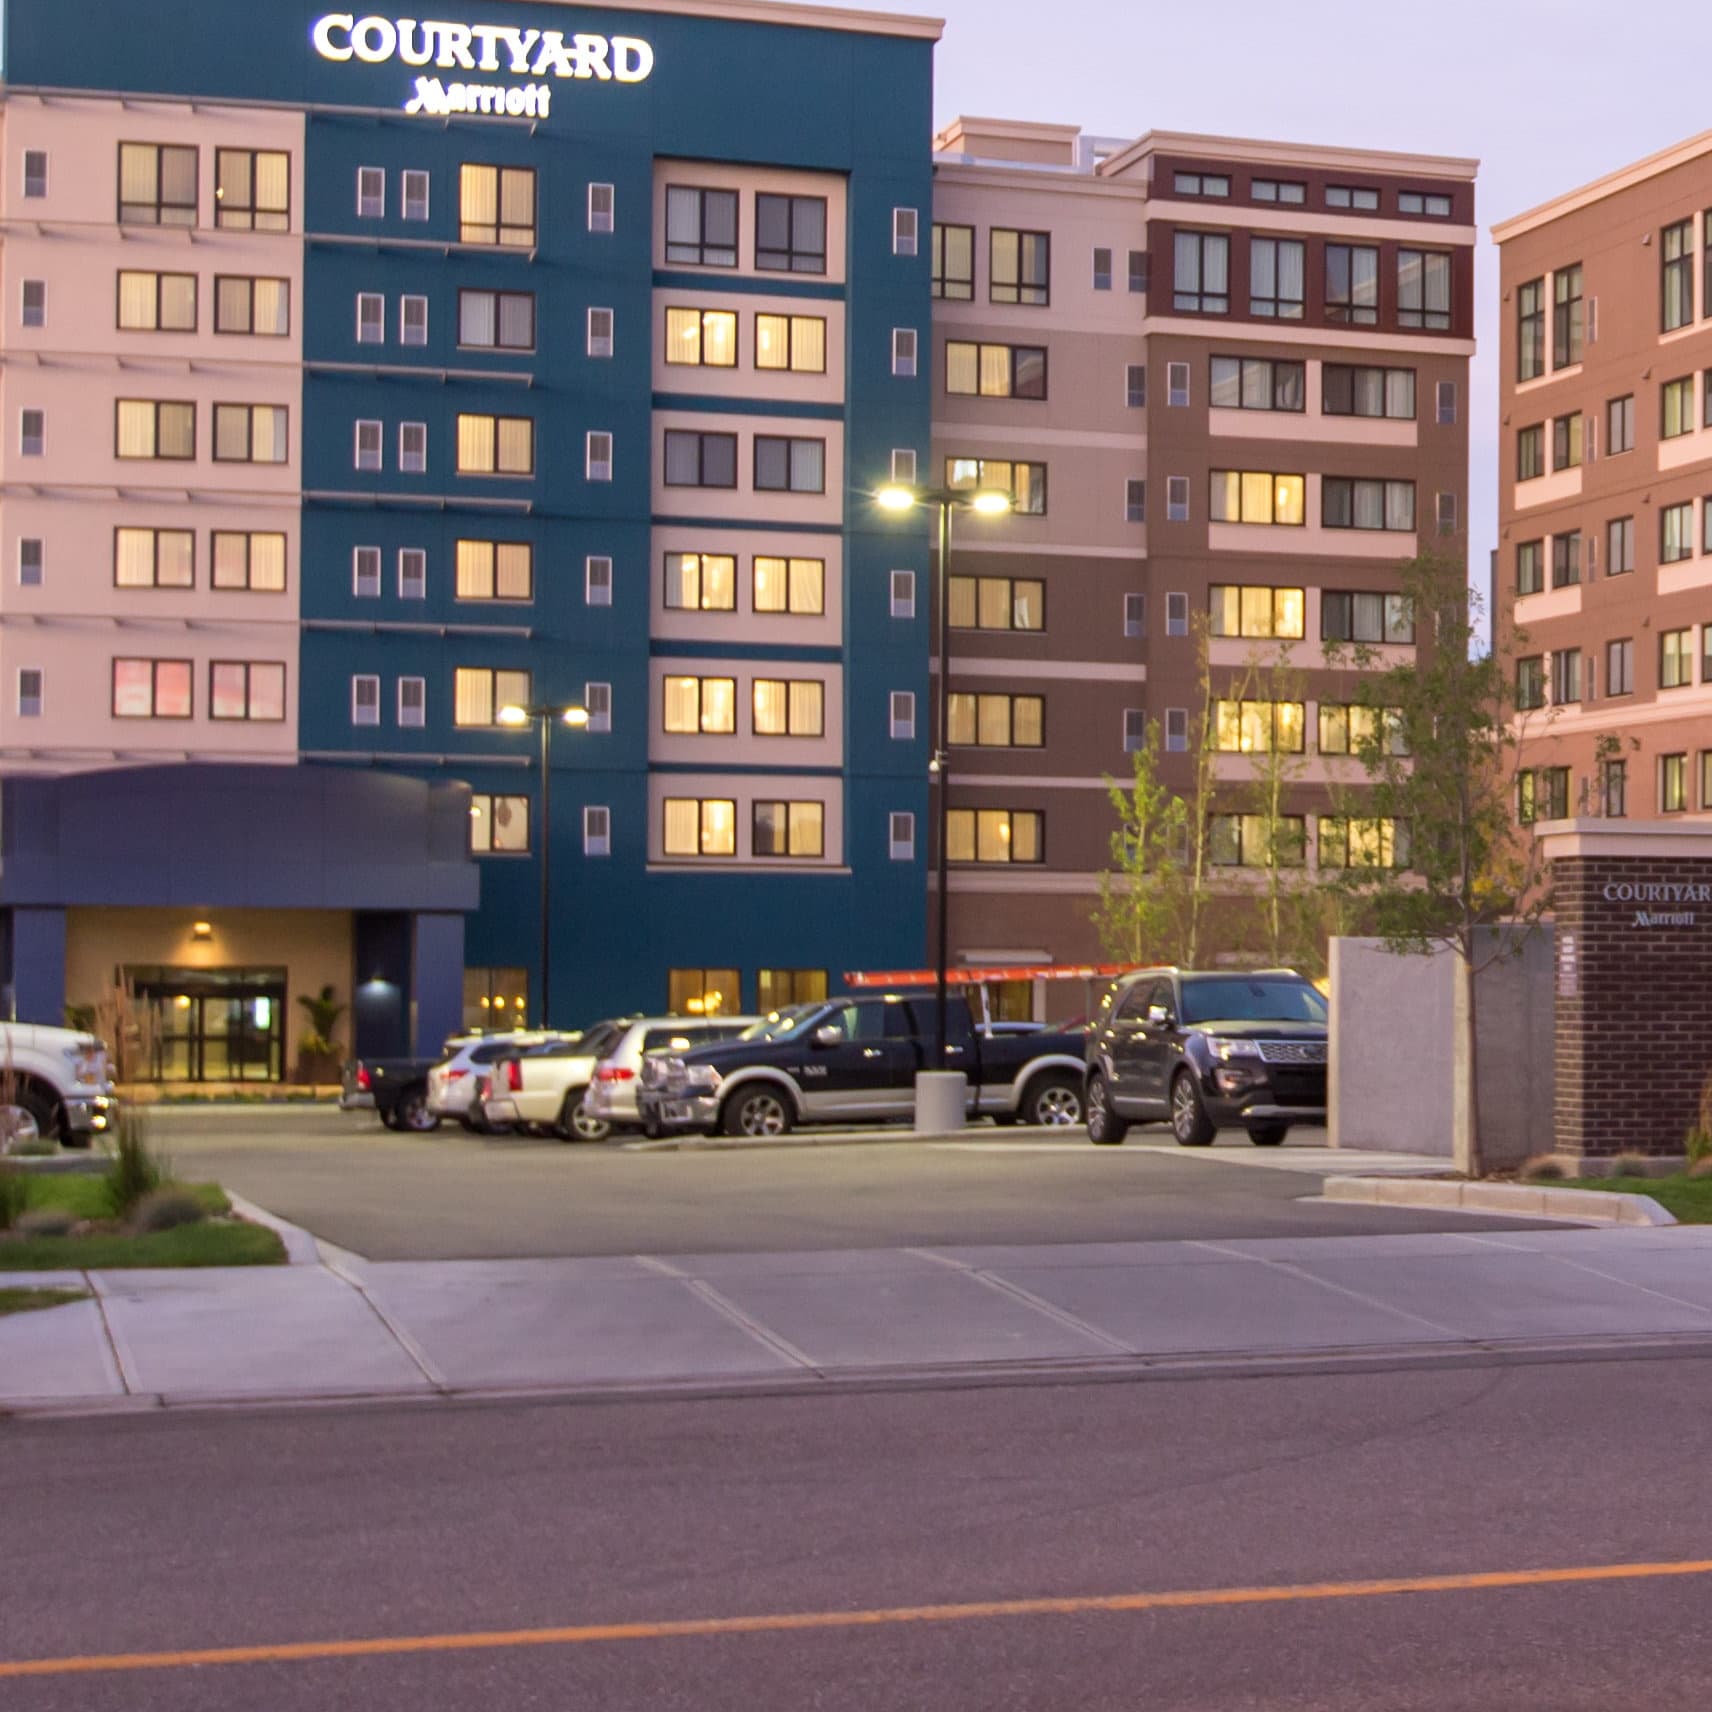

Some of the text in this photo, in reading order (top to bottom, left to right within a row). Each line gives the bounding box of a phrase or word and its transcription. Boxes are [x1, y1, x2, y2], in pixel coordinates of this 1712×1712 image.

[312, 13, 655, 83] COURTYARD
[405, 76, 552, 119] Marriott
[1631, 910, 1695, 927] Marriott
